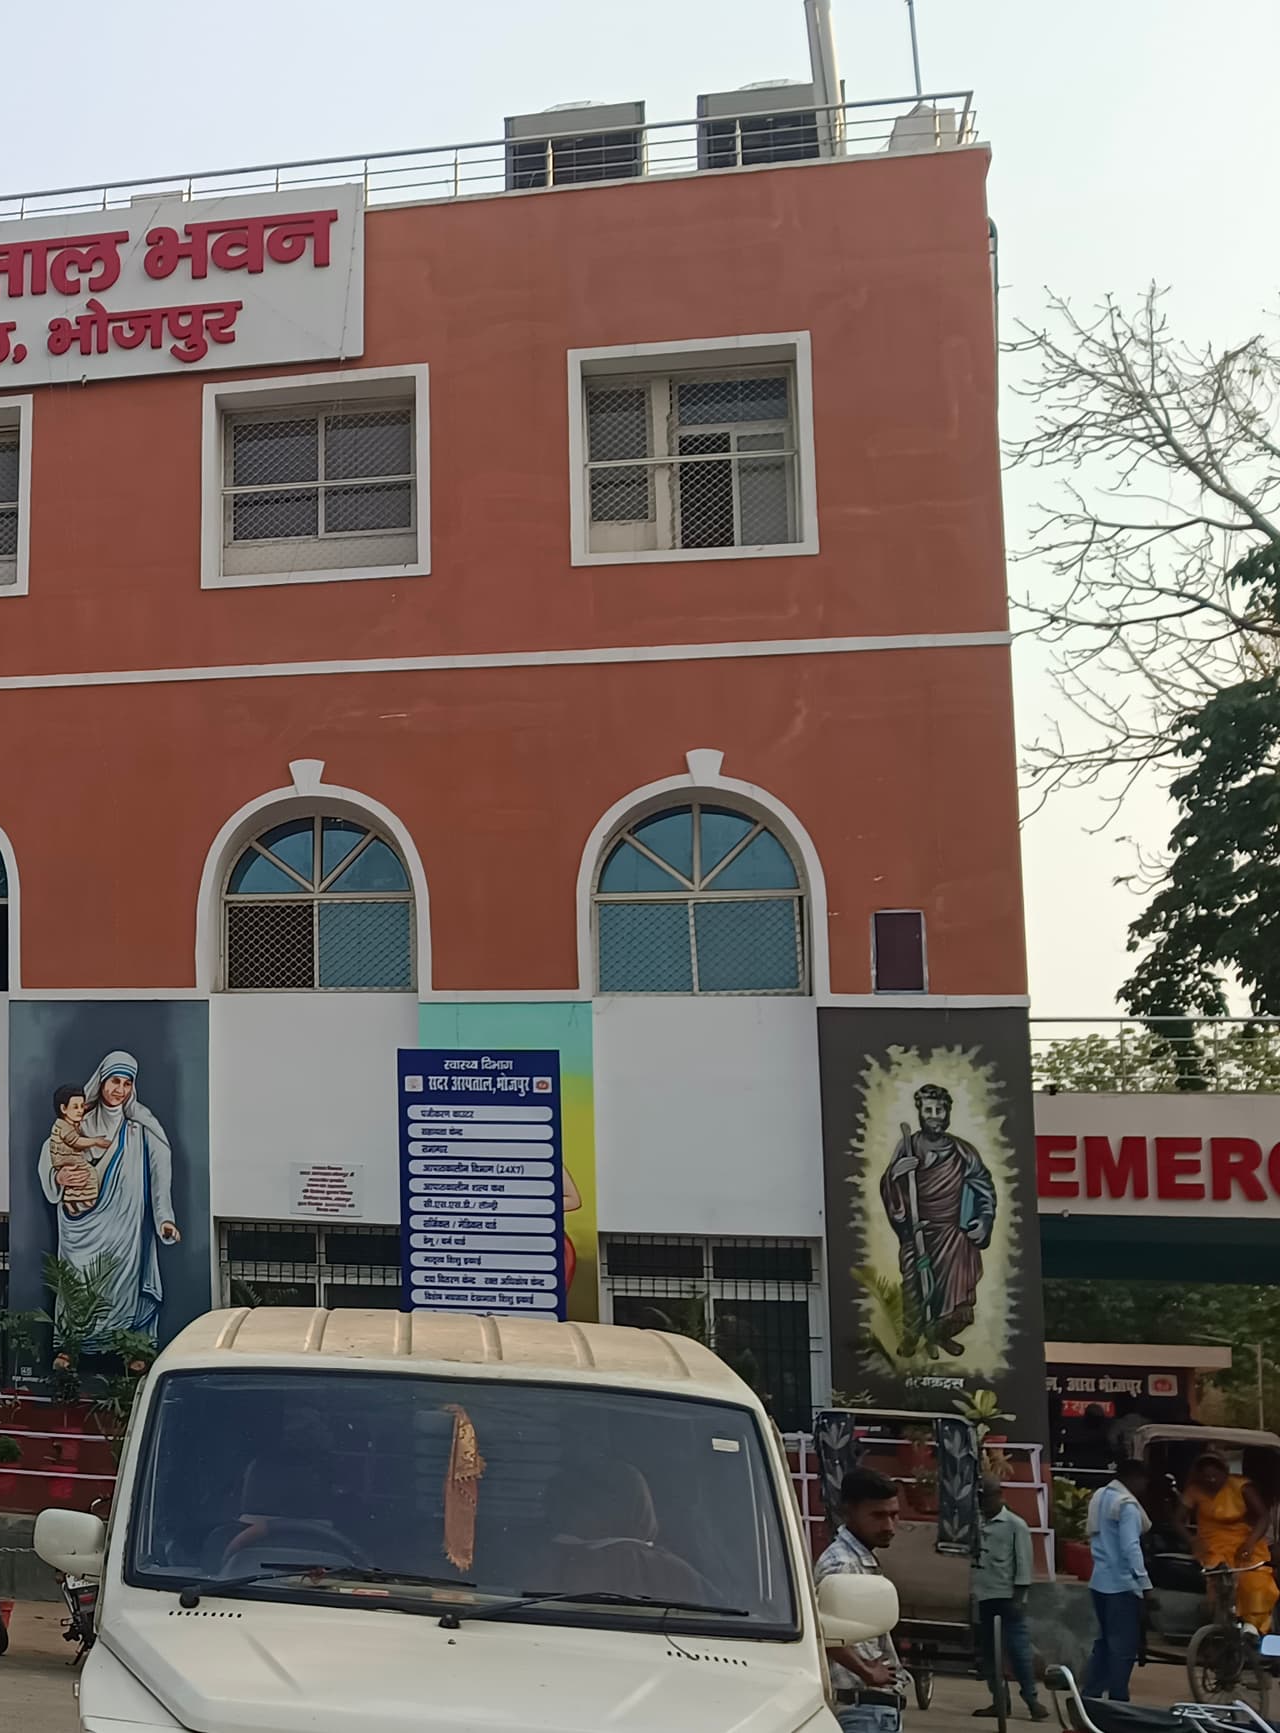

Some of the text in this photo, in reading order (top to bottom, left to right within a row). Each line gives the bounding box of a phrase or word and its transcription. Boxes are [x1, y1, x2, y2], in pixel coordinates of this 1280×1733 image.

[144, 208, 339, 280] भवन
[47, 298, 243, 364] भोजपुर
[427, 1075, 449, 1091] सदर
[443, 1055, 514, 1070] स्वास्थ्य विभाग
[1035, 1134, 1280, 1202] EMER
